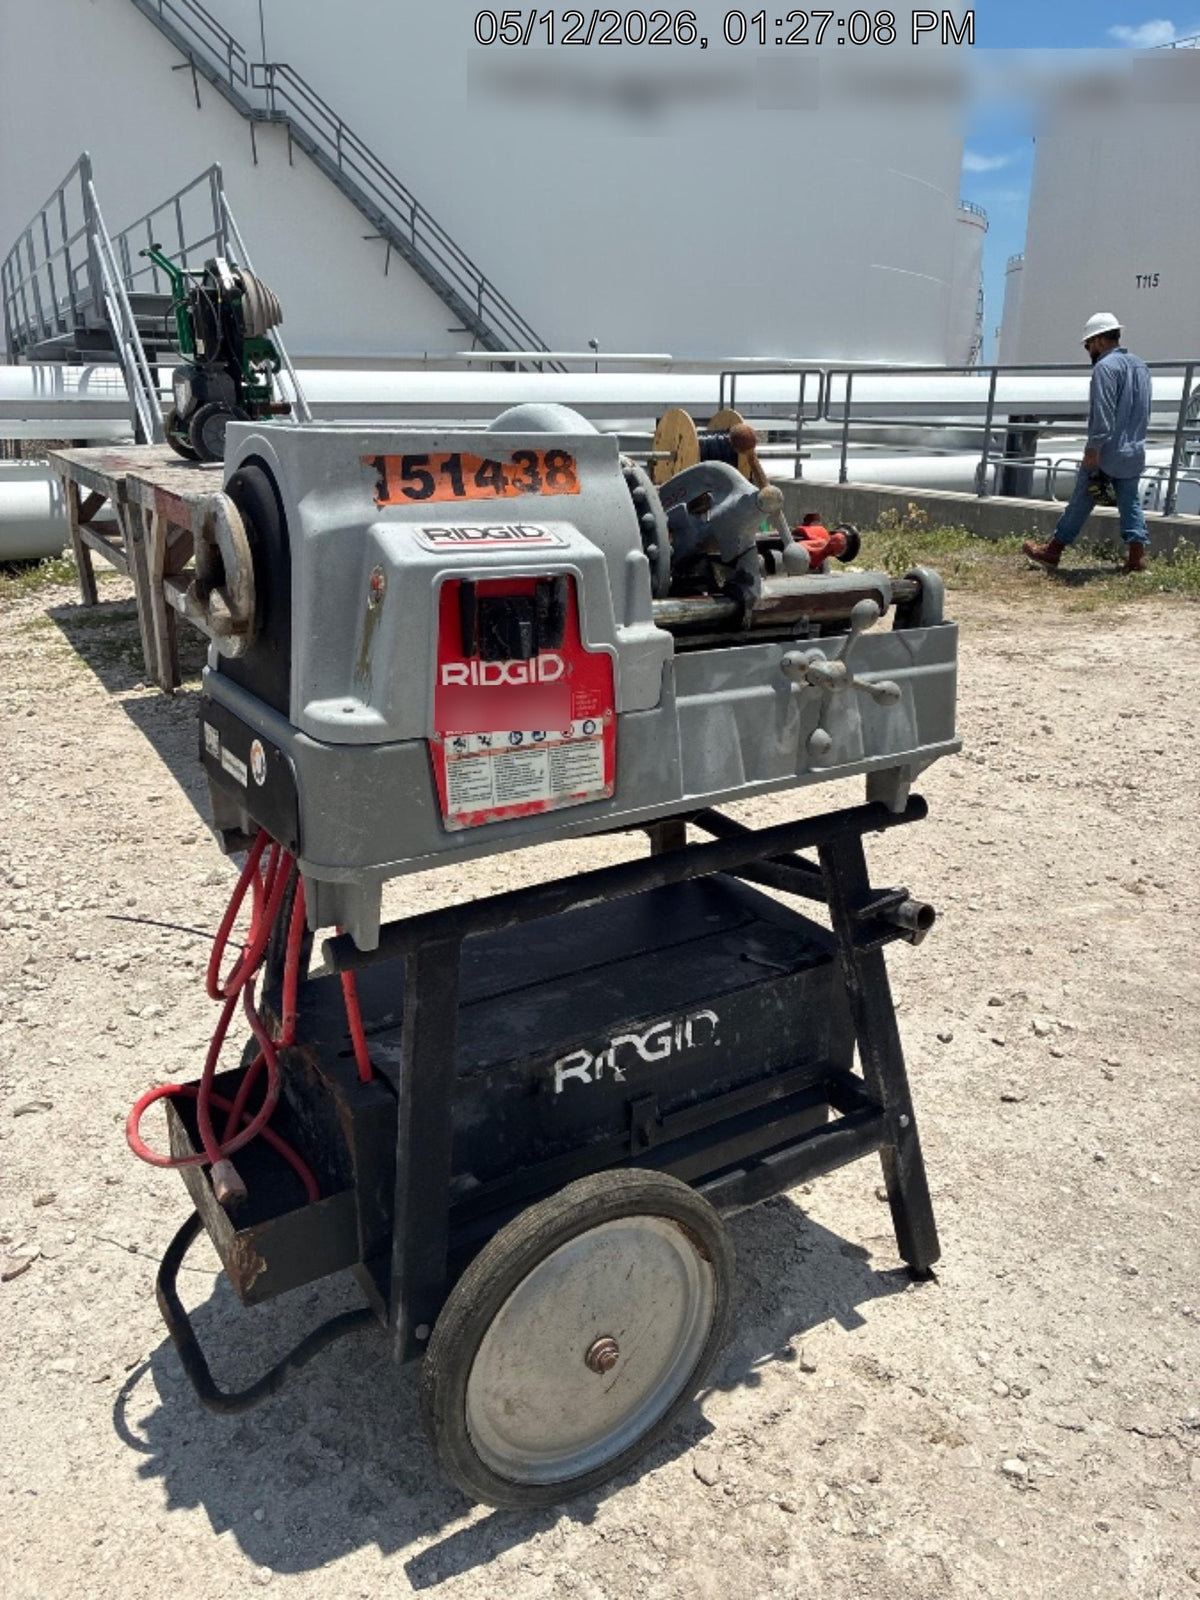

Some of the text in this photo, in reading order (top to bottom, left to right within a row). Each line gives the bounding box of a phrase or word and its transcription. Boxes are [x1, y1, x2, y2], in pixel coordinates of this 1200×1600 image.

[1135, 273, 1160, 288] T115
[370, 449, 577, 501] 151438
[422, 525, 545, 542] RIDGID
[441, 653, 565, 686] RIDGID
